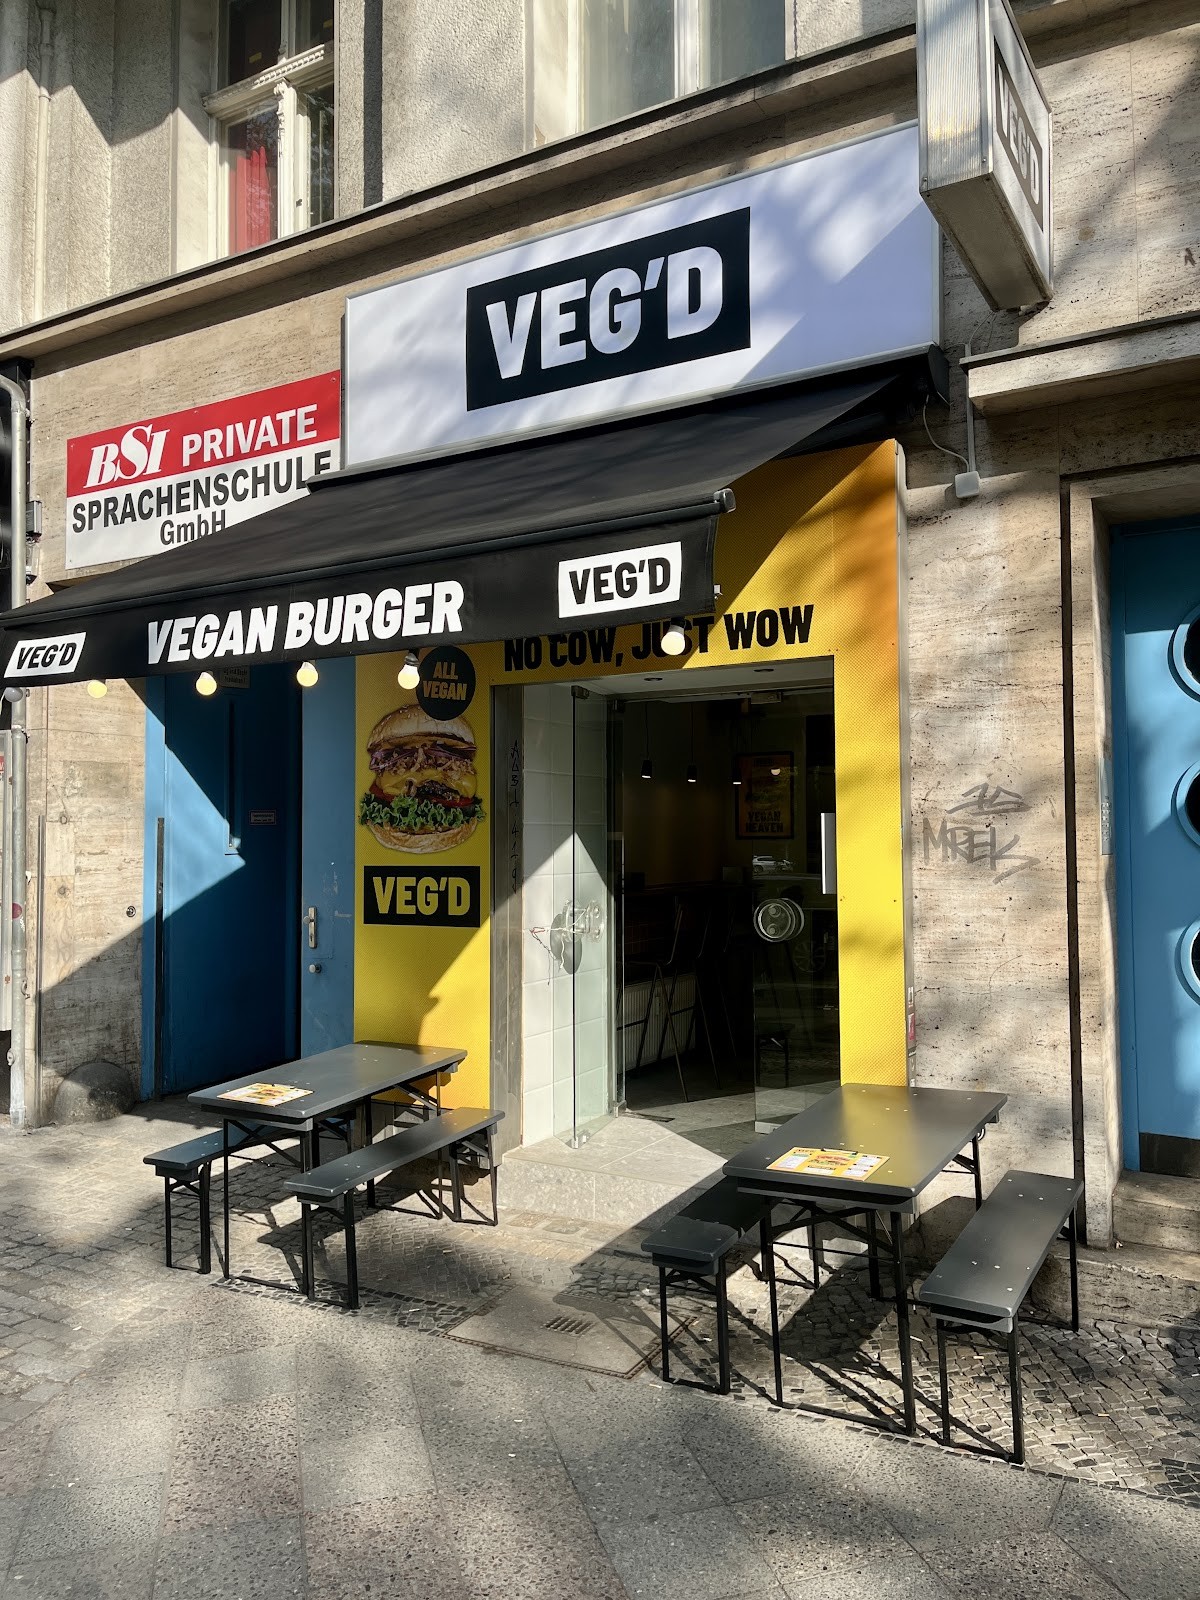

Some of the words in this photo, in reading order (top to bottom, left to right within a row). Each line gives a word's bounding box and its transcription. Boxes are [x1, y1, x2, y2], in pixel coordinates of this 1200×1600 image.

[998, 63, 1040, 205] VEG'D
[485, 245, 724, 380] VEG'D
[83, 424, 170, 489] BSI
[182, 403, 318, 467] PRIVATE
[72, 450, 332, 533] SPRACHENSCHULE
[160, 509, 226, 545] GmbH
[568, 557, 671, 605] VEG'D
[147, 606, 278, 665] VEGAN
[283, 580, 465, 650] BURGER
[503, 636, 543, 672] NO
[723, 604, 815, 651] WOW
[16, 642, 77, 670] VEG'D
[432, 660, 459, 681] ALL
[422, 681, 468, 702] VEGAN
[373, 876, 472, 917] VEG'D
